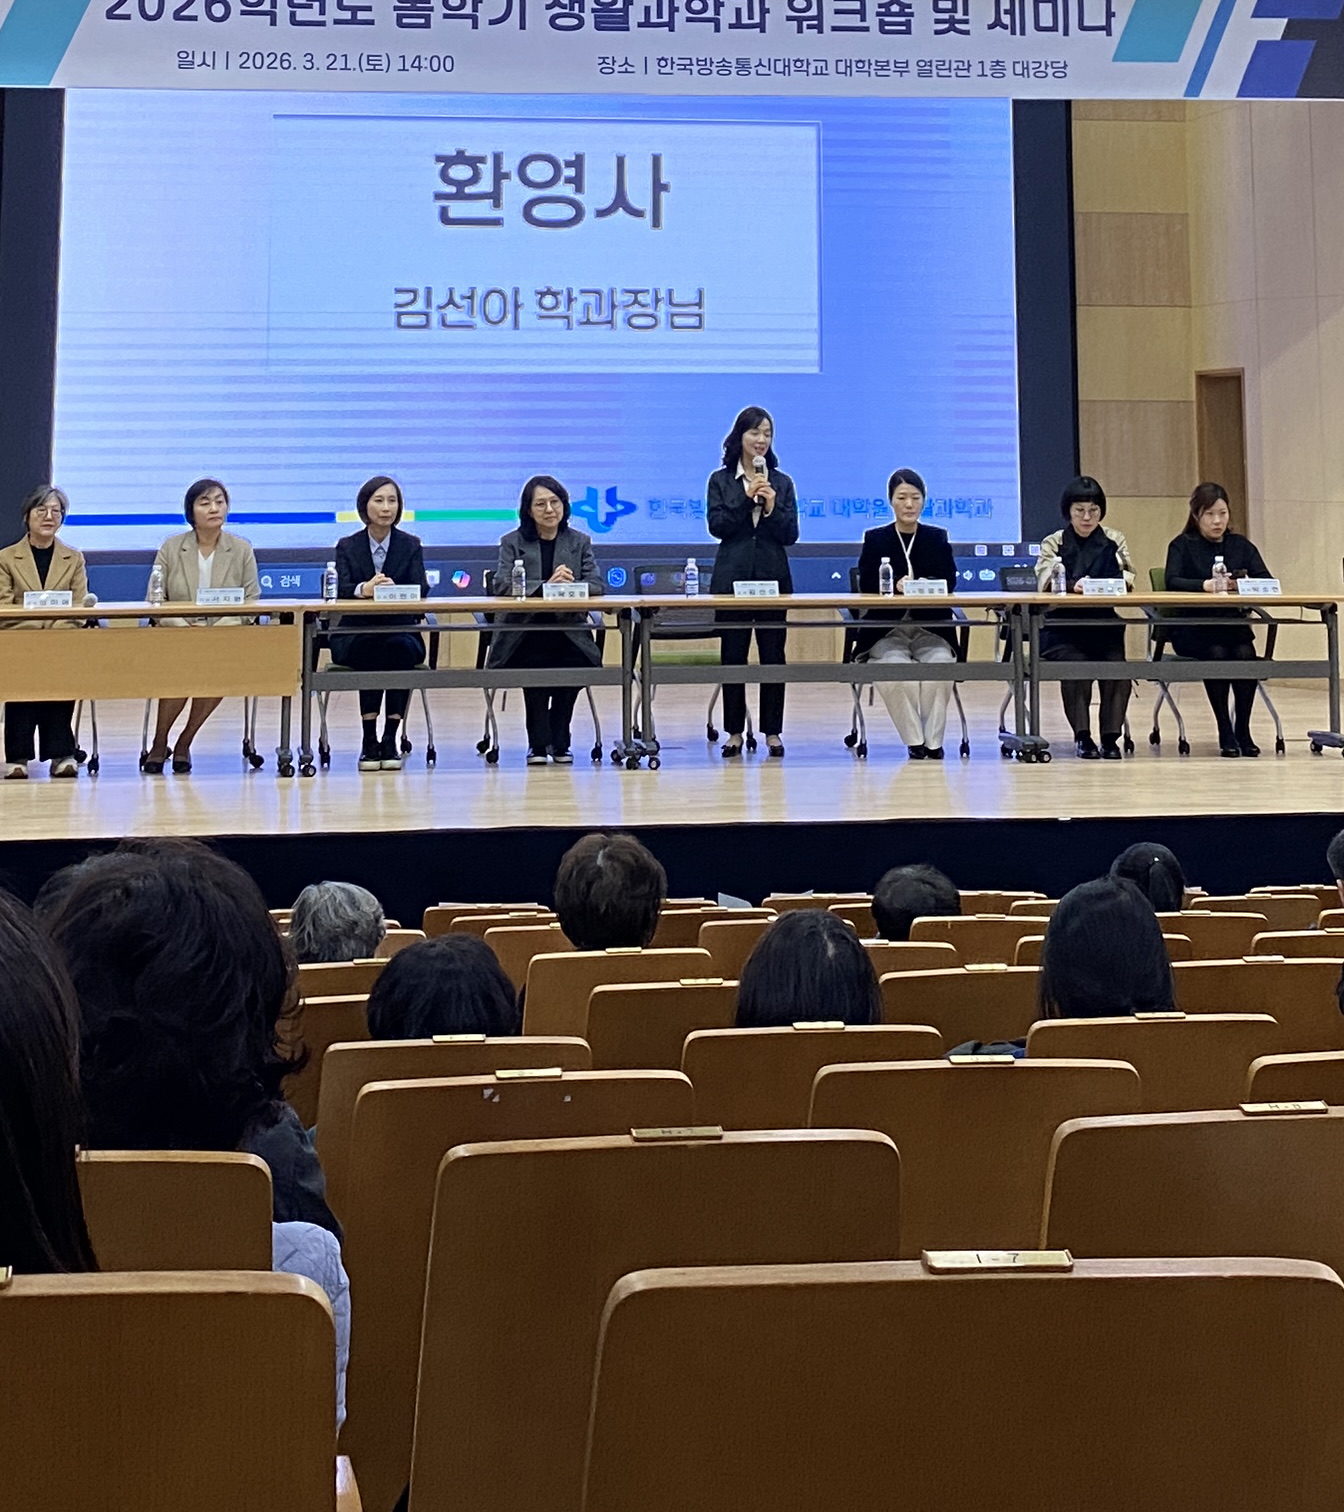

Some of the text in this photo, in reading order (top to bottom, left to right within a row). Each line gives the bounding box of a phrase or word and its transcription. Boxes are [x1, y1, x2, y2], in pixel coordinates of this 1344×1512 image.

[176, 48, 217, 71] 일시
[238, 51, 297, 71] 2026.
[302, 52, 320, 71] 3.
[325, 52, 391, 74] 21.(토)
[396, 54, 455, 73] 14:00
[597, 54, 636, 77] 장소
[655, 55, 831, 78] 한국방송통신대학교
[834, 57, 912, 79] 대학본부
[915, 58, 973, 79] 열린관
[976, 59, 1008, 80] 1층
[1012, 59, 1069, 81] 대강당
[432, 147, 672, 230] 환영사
[393, 284, 705, 333] 김선아 학과장님
[279, 574, 302, 588] 검색
